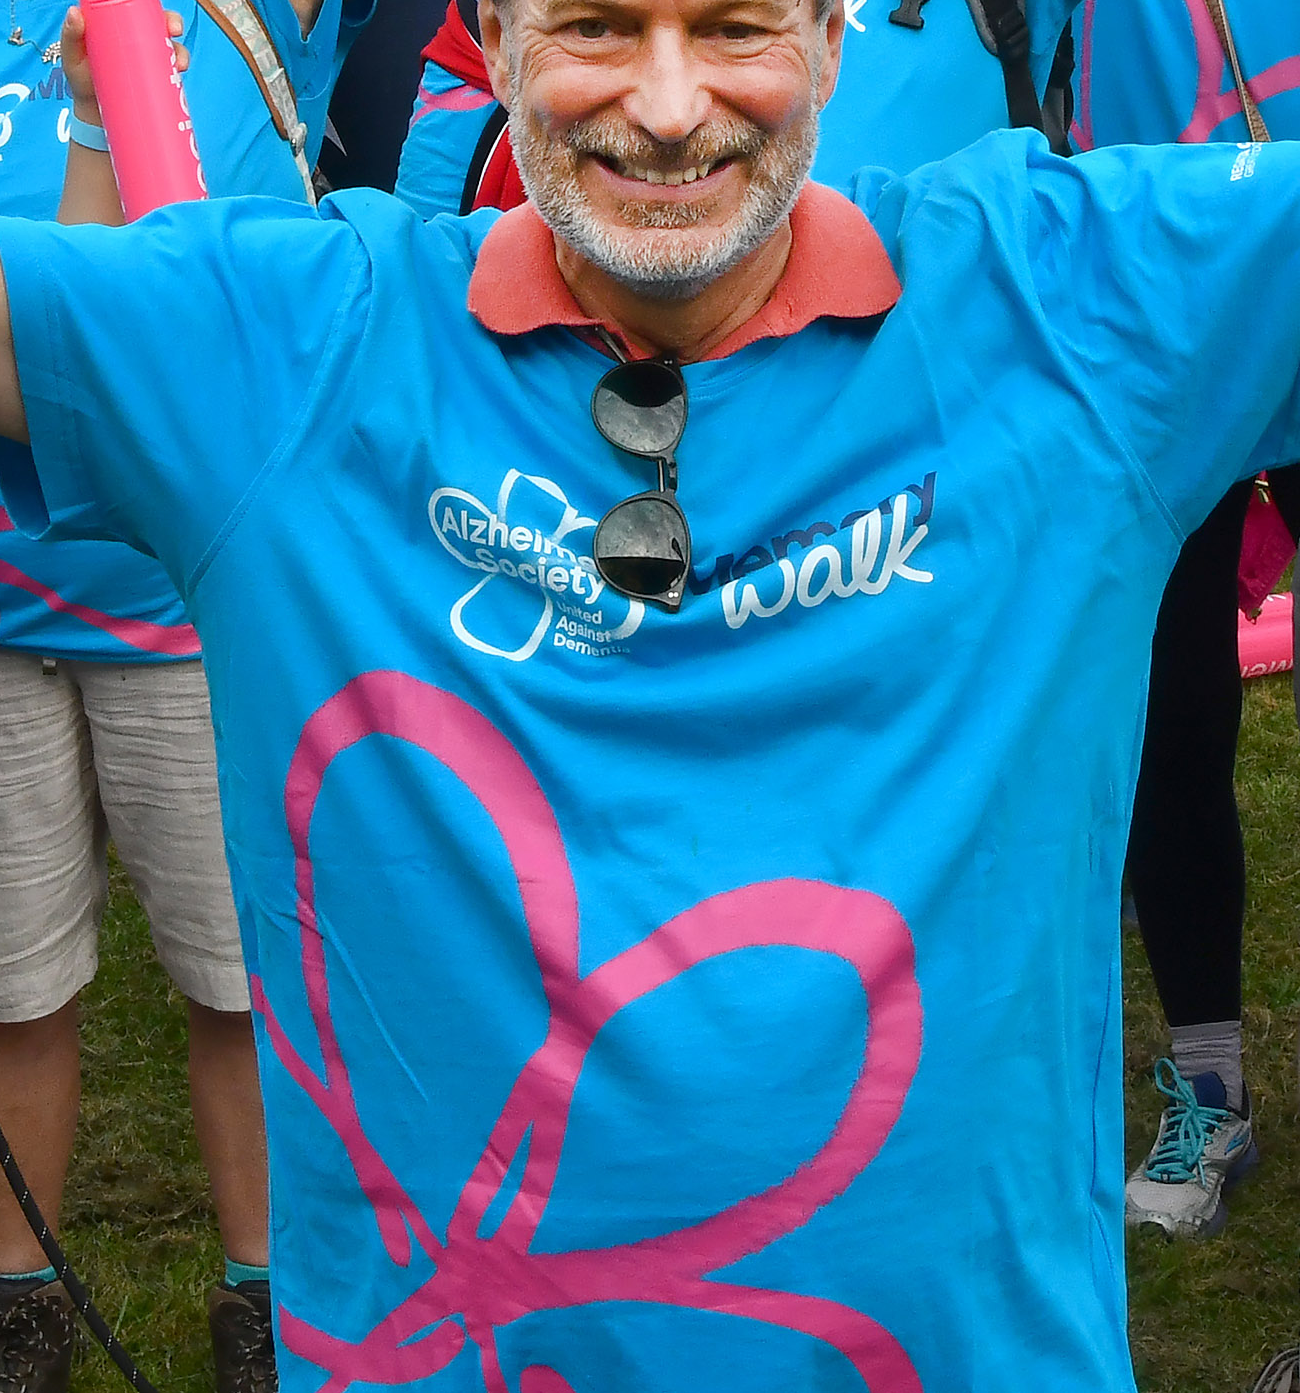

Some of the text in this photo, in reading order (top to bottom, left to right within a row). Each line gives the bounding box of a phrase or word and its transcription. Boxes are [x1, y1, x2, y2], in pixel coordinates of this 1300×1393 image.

[474, 547, 606, 604] Society
[721, 494, 934, 630] walk
[556, 617, 612, 643] Against
